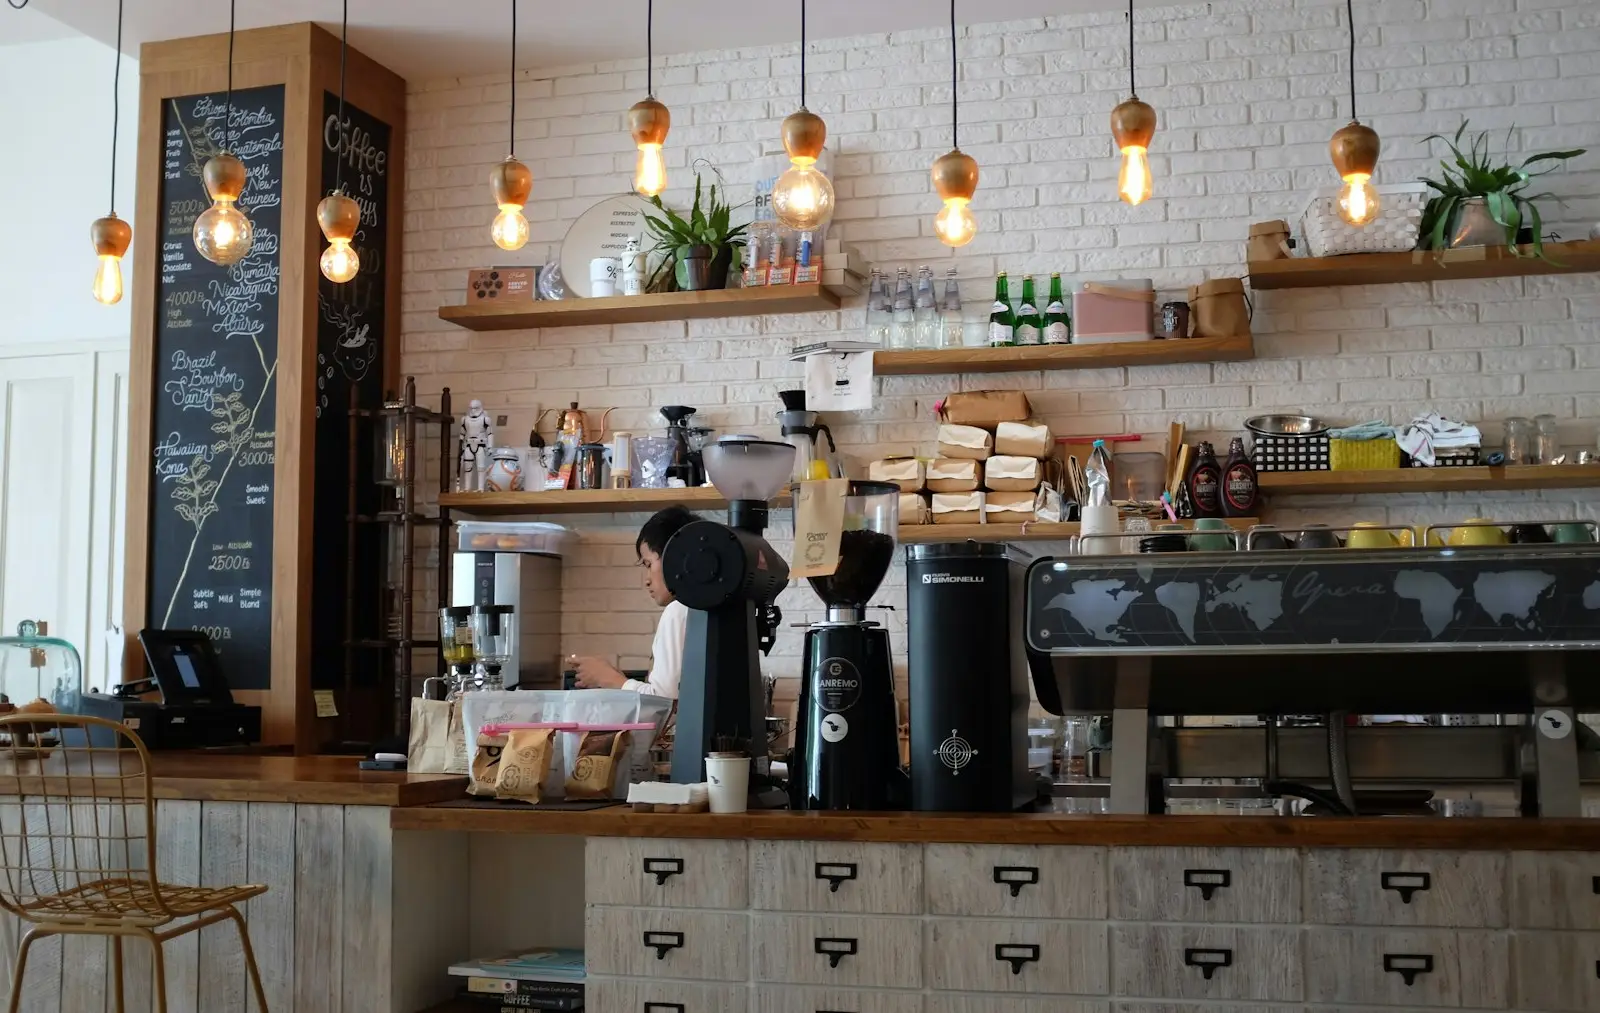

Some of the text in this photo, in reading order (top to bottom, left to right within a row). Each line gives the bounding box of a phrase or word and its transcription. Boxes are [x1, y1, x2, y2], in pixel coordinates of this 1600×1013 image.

[228, 106, 276, 134] Colombia
[228, 132, 284, 160] Guatemala
[324, 114, 386, 176] Coffee
[246, 177, 279, 191] New
[359, 173, 373, 196] is
[169, 199, 198, 215] 5000
[238, 190, 281, 214] Guinea
[163, 242, 183, 251] Citrus
[163, 253, 184, 262] Vanilla
[162, 263, 192, 273] Chocolate
[233, 257, 281, 285] Sumatra
[162, 275, 176, 284] Nut
[165, 290, 197, 307] 4000
[208, 279, 278, 302] Nicaragua
[167, 309, 182, 318] High
[201, 299, 262, 317] Mexico
[212, 313, 265, 340] Altura
[171, 349, 217, 371] Brazil
[188, 366, 245, 392] Bourbon
[164, 376, 214, 412] Santos
[153, 431, 214, 463] Hawaiian
[238, 451, 269, 467] 3000
[155, 458, 188, 484] Kona
[245, 484, 269, 493] Smooth
[245, 496, 266, 505] Sweet
[208, 555, 242, 571] 2500
[932, 576, 984, 584] SIMONELLI
[193, 589, 214, 599] Subtle
[218, 595, 234, 604] Mild
[239, 588, 262, 599] Simple
[193, 600, 209, 610] Soft
[819, 679, 858, 688] ANREMO
